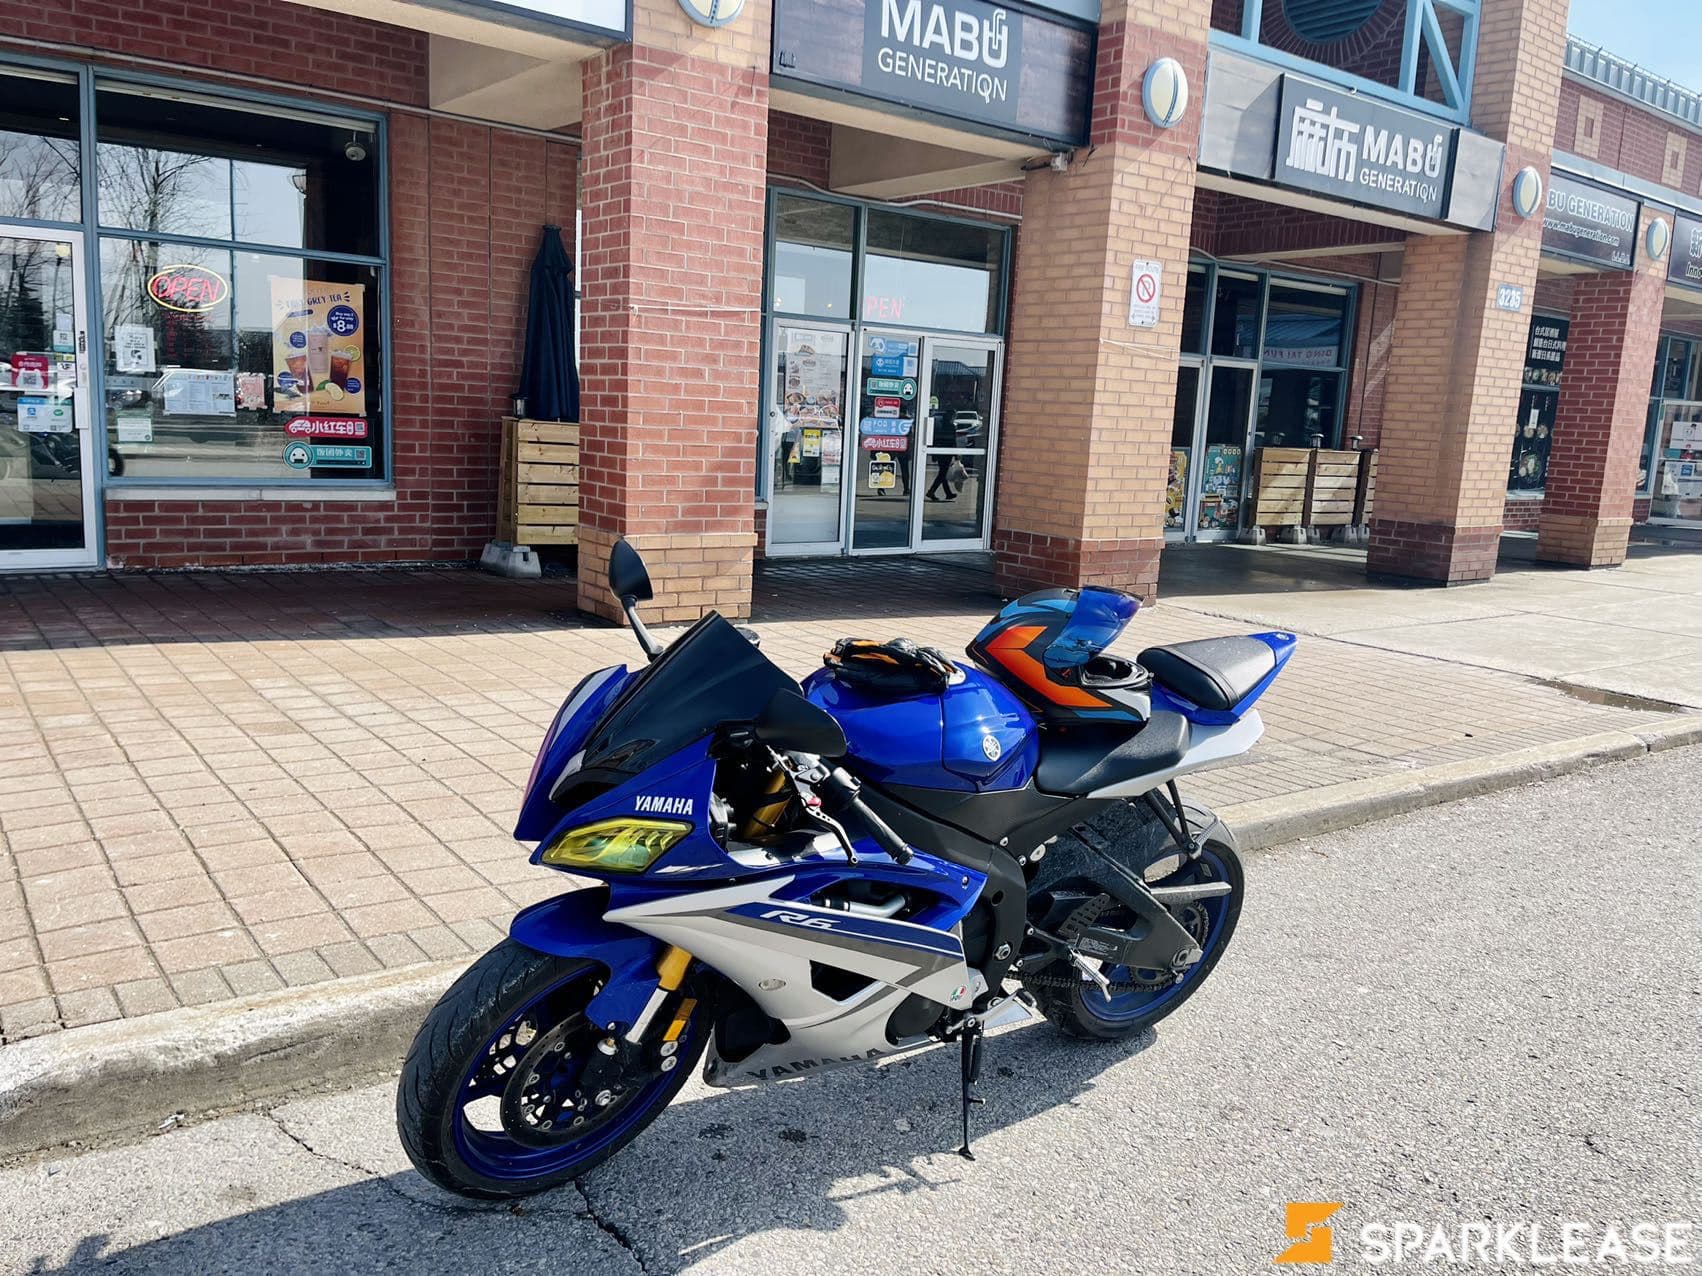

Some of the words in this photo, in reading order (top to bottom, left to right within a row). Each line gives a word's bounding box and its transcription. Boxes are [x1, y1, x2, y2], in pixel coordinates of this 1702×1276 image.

[877, 47, 1007, 104] GENERATION
[1359, 168, 1438, 204] GENERATION
[1547, 189, 1567, 213] BU
[1568, 197, 1635, 233] GENERATION
[152, 275, 221, 301] OPEN
[866, 296, 903, 320] PEN
[634, 795, 694, 816] YAMAHA
[760, 910, 841, 930] R6
